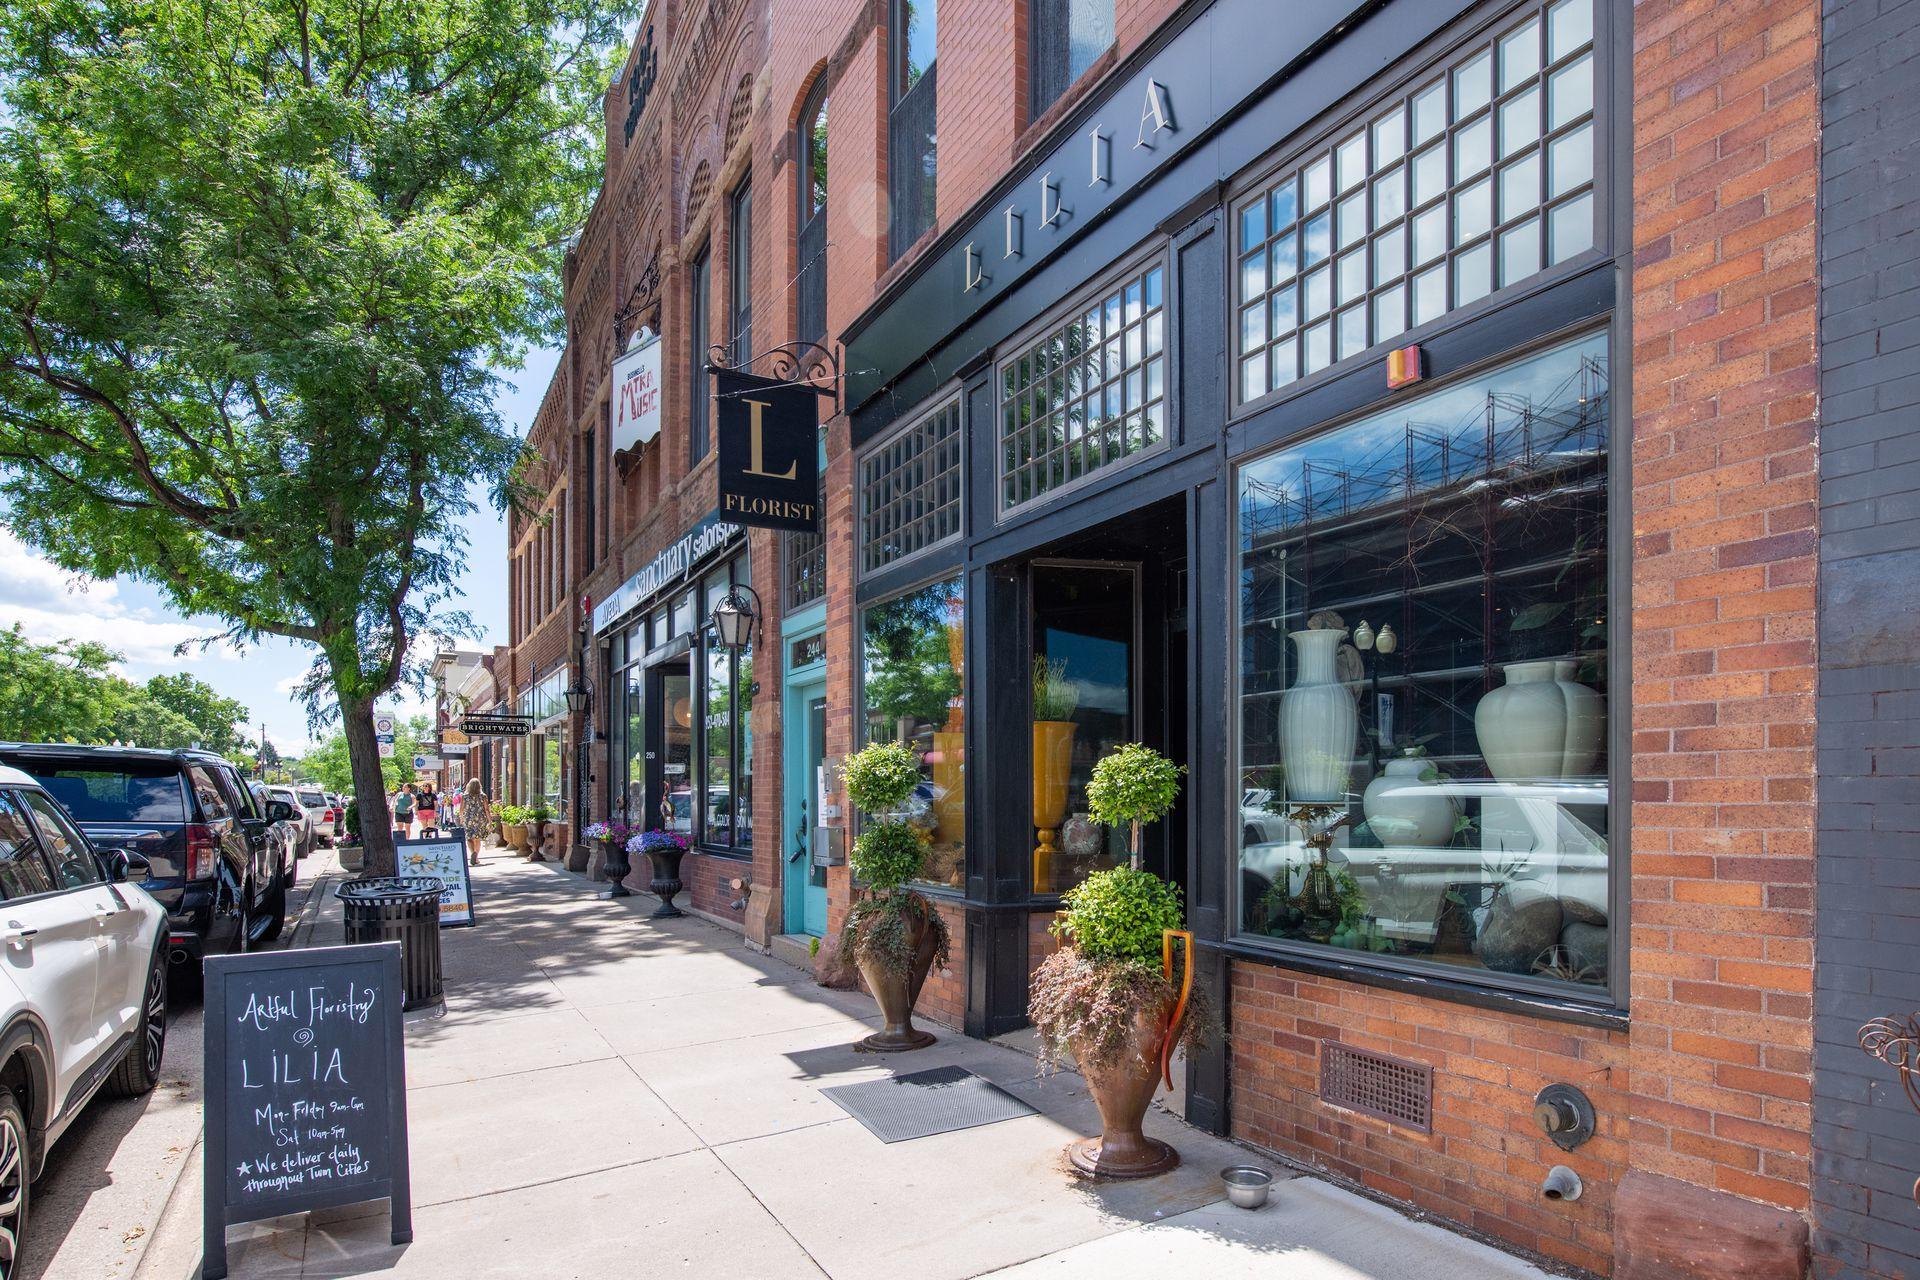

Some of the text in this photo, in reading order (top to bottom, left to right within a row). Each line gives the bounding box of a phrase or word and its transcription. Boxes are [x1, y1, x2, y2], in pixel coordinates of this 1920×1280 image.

[964, 76, 1168, 294] LILIA
[742, 398, 797, 481] L
[725, 494, 814, 520] FLORIST
[635, 533, 693, 601] sanctuary
[807, 642, 820, 658] 244
[461, 723, 529, 733] BRIGHTWATER
[645, 751, 656, 759] 250
[309, 982, 375, 1027] Floristry
[276, 1128, 299, 1146] Sat
[255, 1142, 361, 1174] We deliver daily
[242, 1171, 305, 1193] throughout
[336, 1160, 370, 1178] Cities
